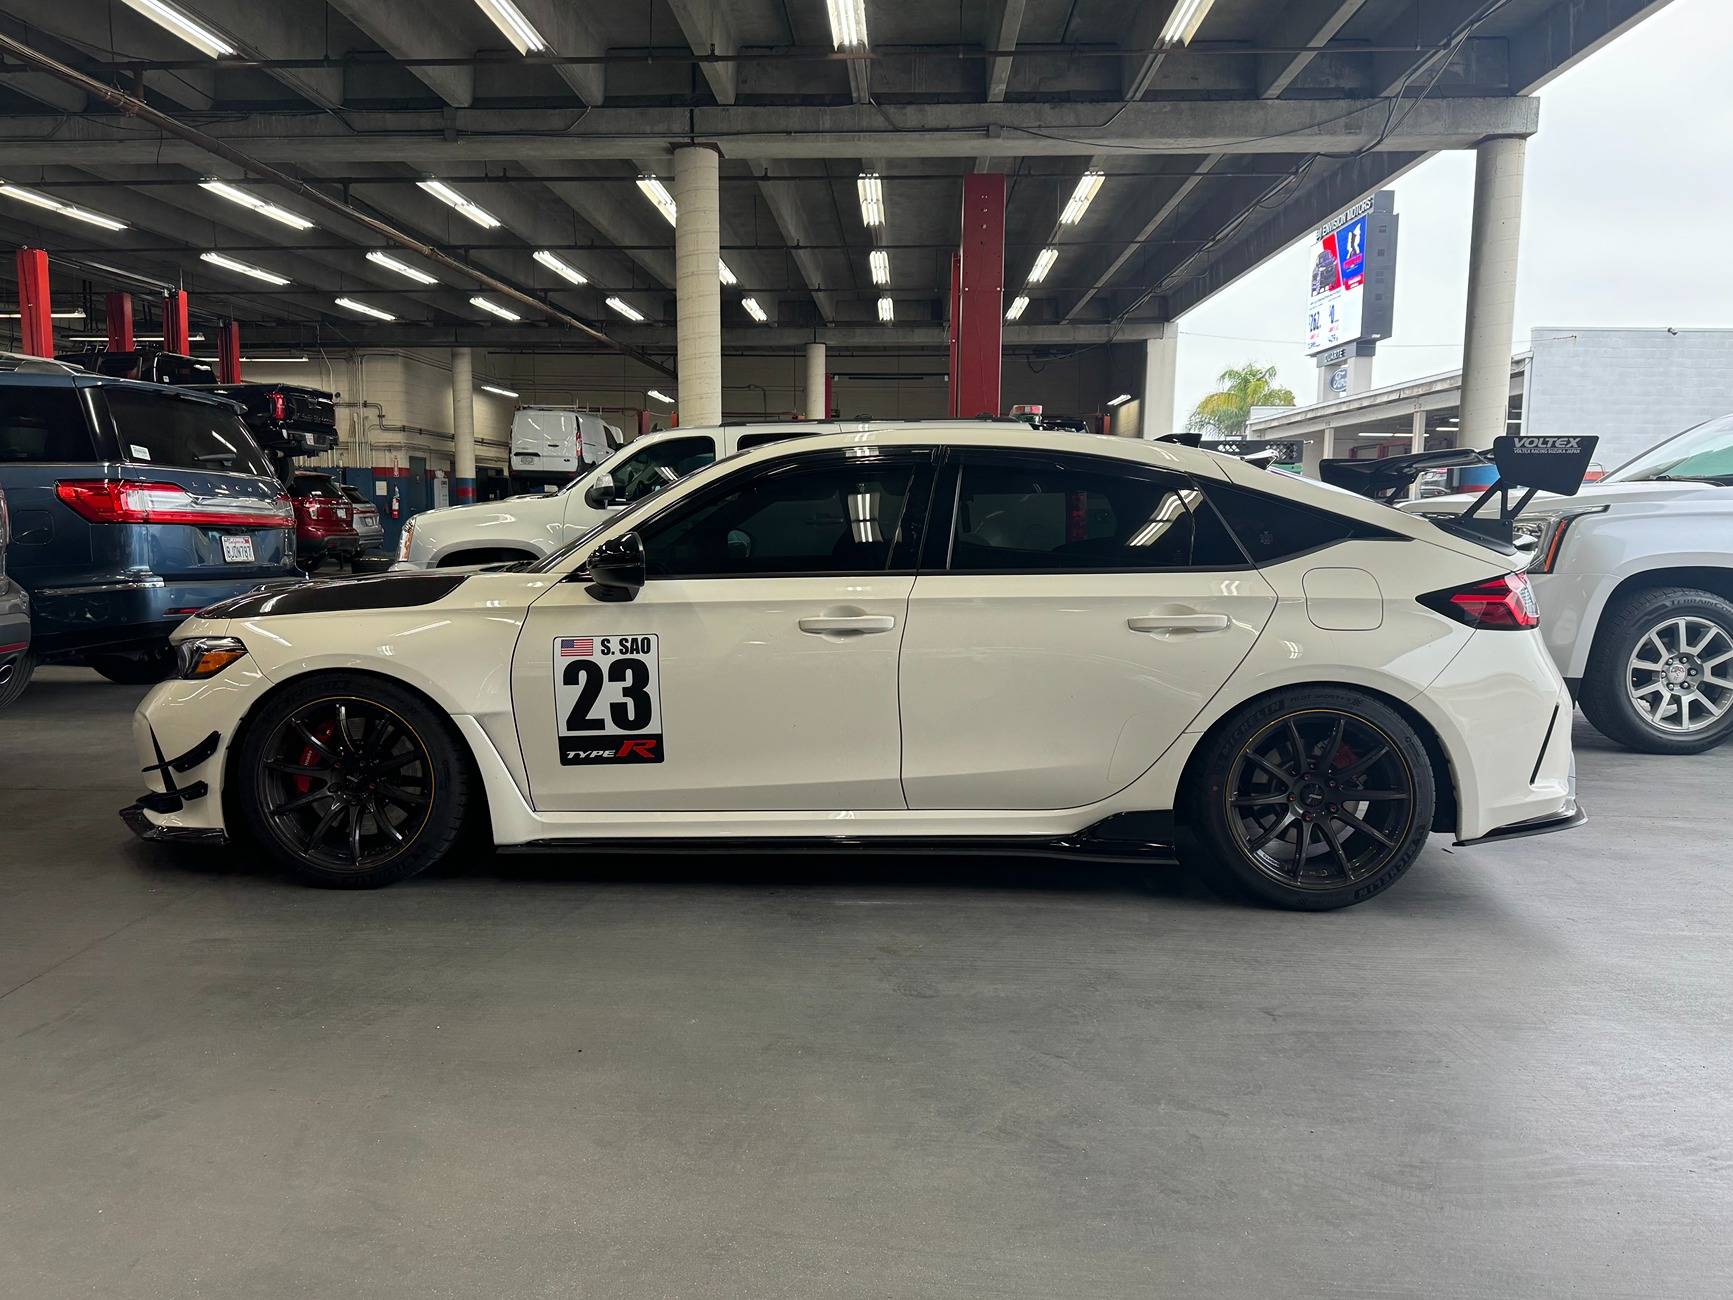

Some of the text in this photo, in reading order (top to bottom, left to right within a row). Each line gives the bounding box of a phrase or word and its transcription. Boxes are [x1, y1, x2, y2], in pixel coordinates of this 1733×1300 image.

[1346, 198, 1372, 220] MOTORS
[1514, 437, 1582, 448] VOLTEX
[600, 637, 651, 656] S. SAO
[563, 658, 652, 732] 23
[566, 739, 657, 759] TYPE R
